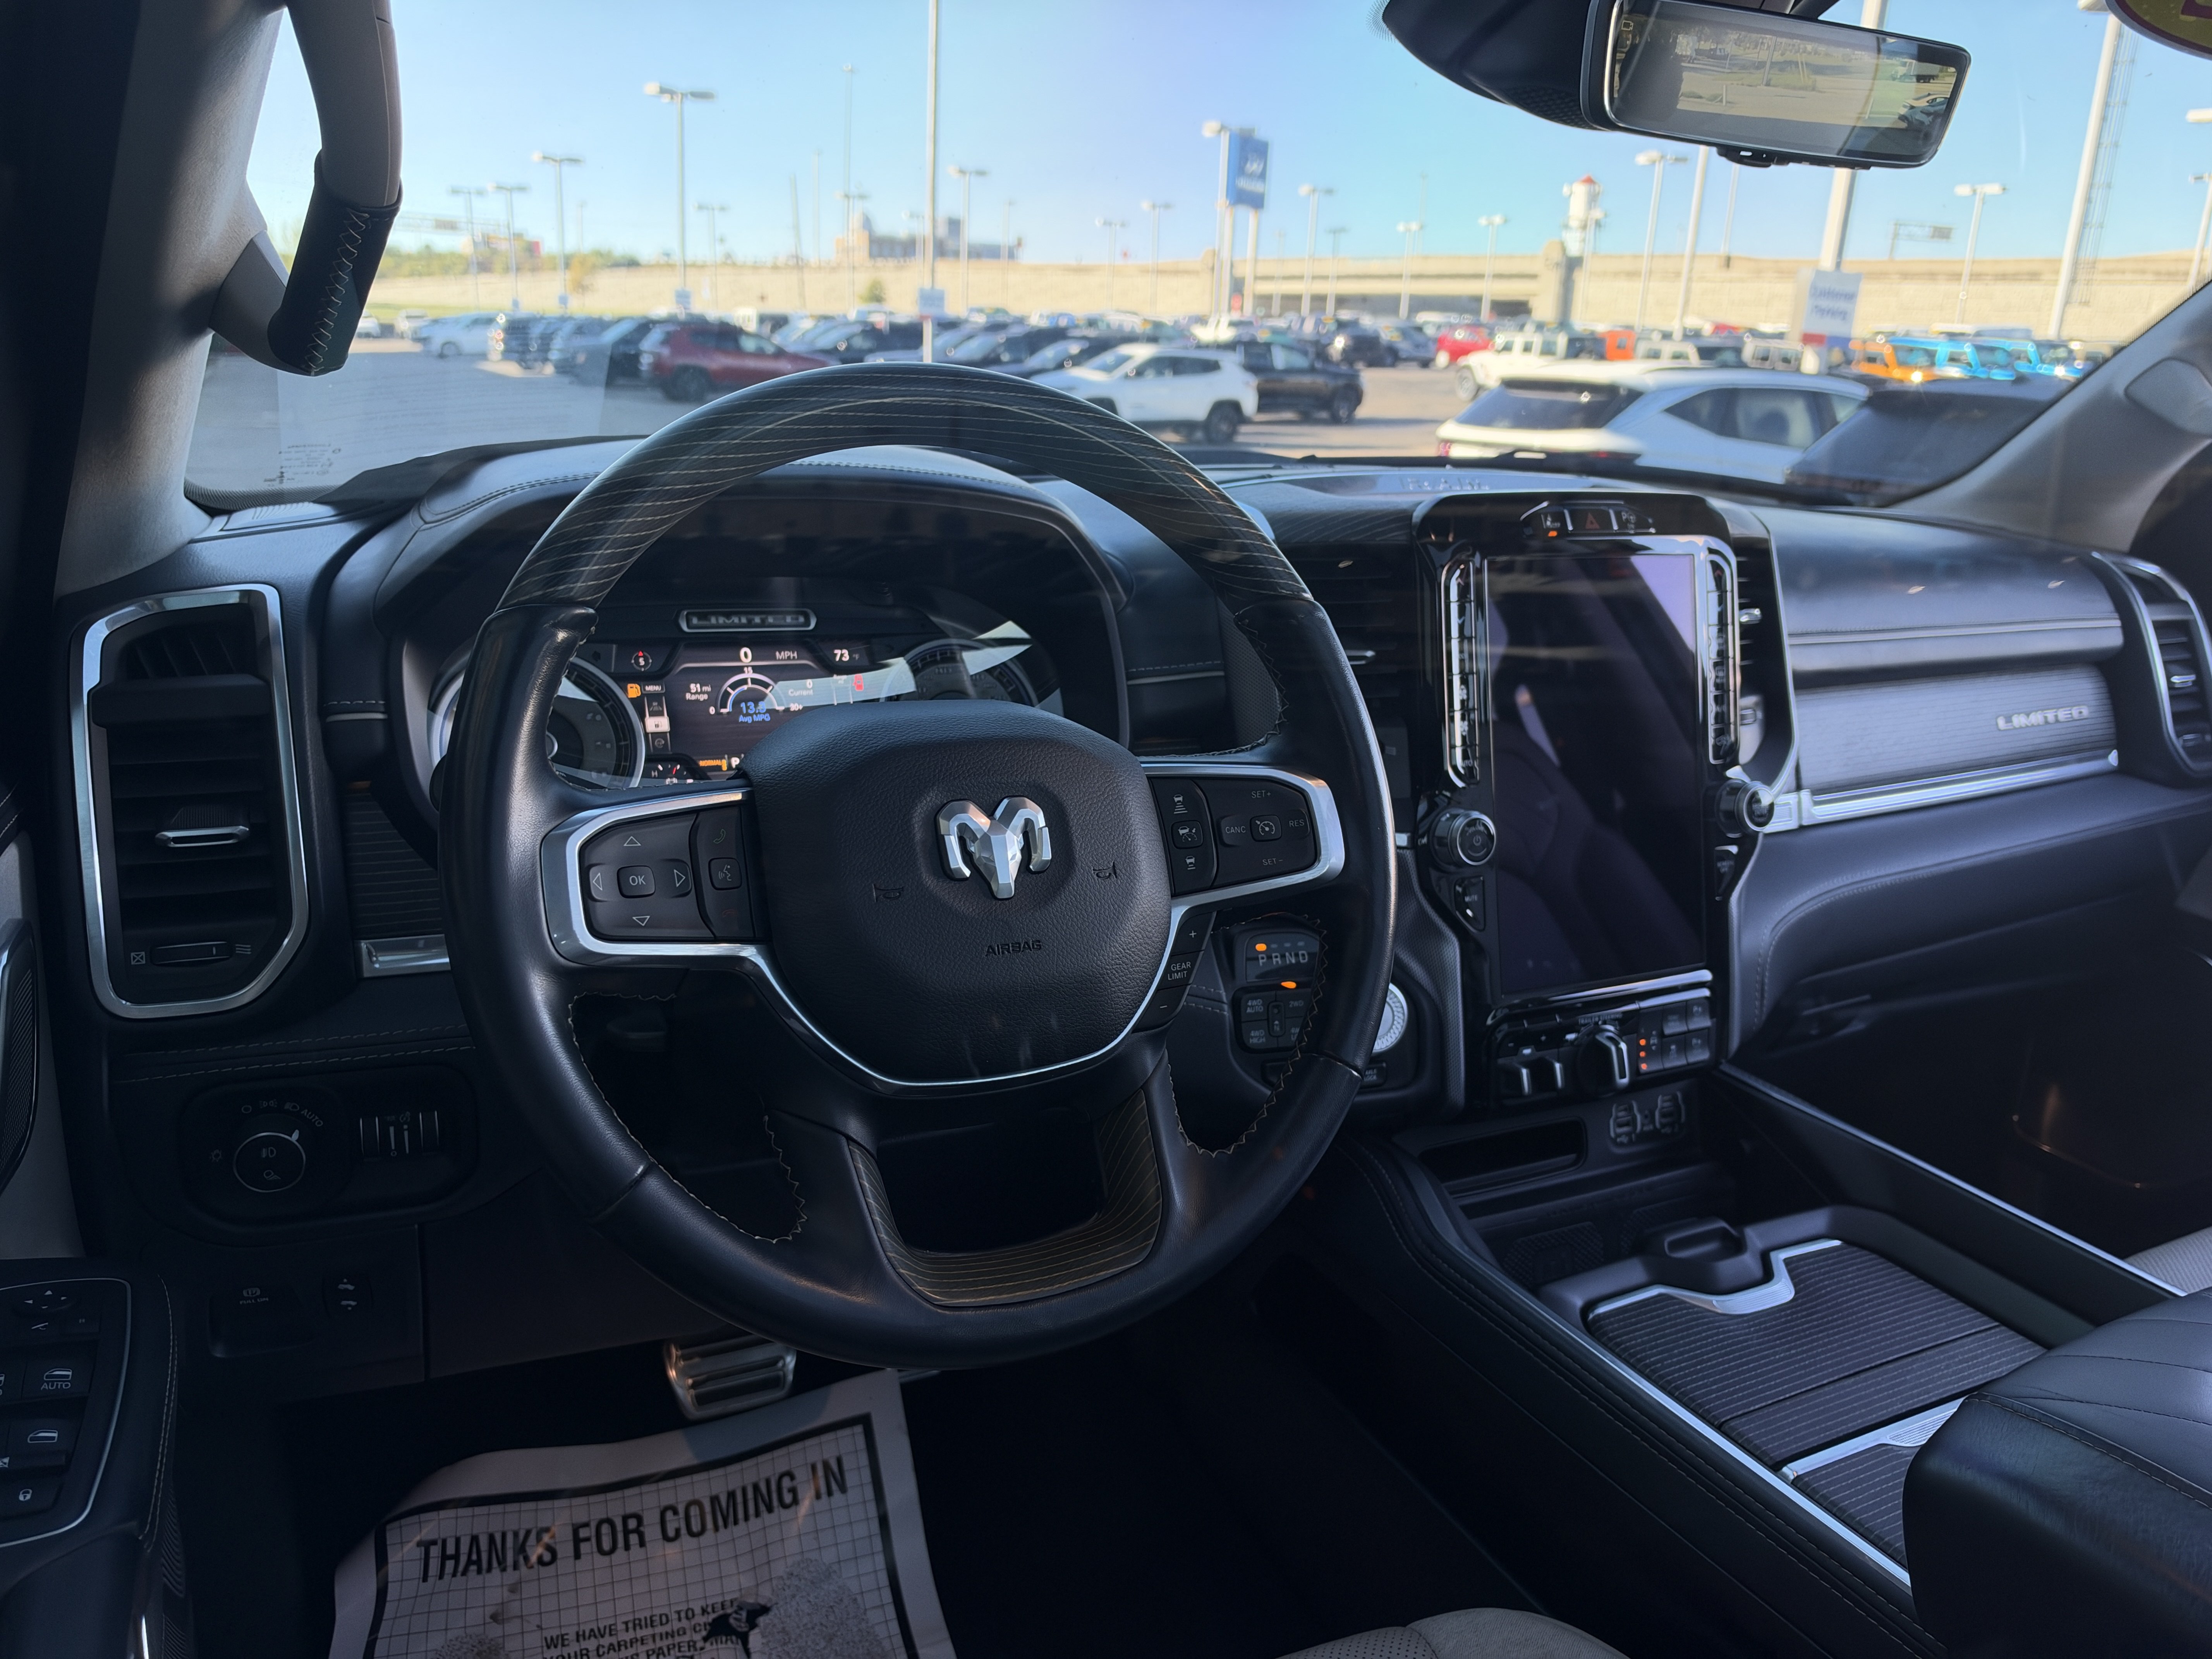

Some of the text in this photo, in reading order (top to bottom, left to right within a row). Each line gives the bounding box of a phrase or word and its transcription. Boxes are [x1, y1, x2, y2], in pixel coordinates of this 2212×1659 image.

[690, 615, 805, 625] LIMITED
[740, 647, 798, 663] 0 MPH
[834, 649, 850, 661] 73
[639, 657, 645, 666] S
[690, 683, 701, 692] 51
[806, 679, 813, 689] 0
[685, 692, 708, 701] Range
[740, 701, 766, 714] 13.3
[738, 714, 771, 723] Avg MPG
[1996, 705, 2088, 730] LIMITED
[1289, 819, 1305, 827] RES
[1225, 826, 1246, 834] CANC
[629, 875, 646, 886] OK
[985, 939, 1042, 957] AIRBAG
[1171, 961, 1191, 971] GEAR
[1168, 970, 1188, 981] LIMIT
[301, 1109, 323, 1127] AUTO
[41, 1382, 71, 1391] AUTO
[416, 1455, 848, 1583] THANKS FOR COMING IN
[544, 1633, 570, 1650] WE
[575, 1623, 618, 1643] HAVE
[622, 1613, 670, 1633] TRIED
[674, 1607, 696, 1623] TO
[596, 1626, 687, 1658] CARPETING
